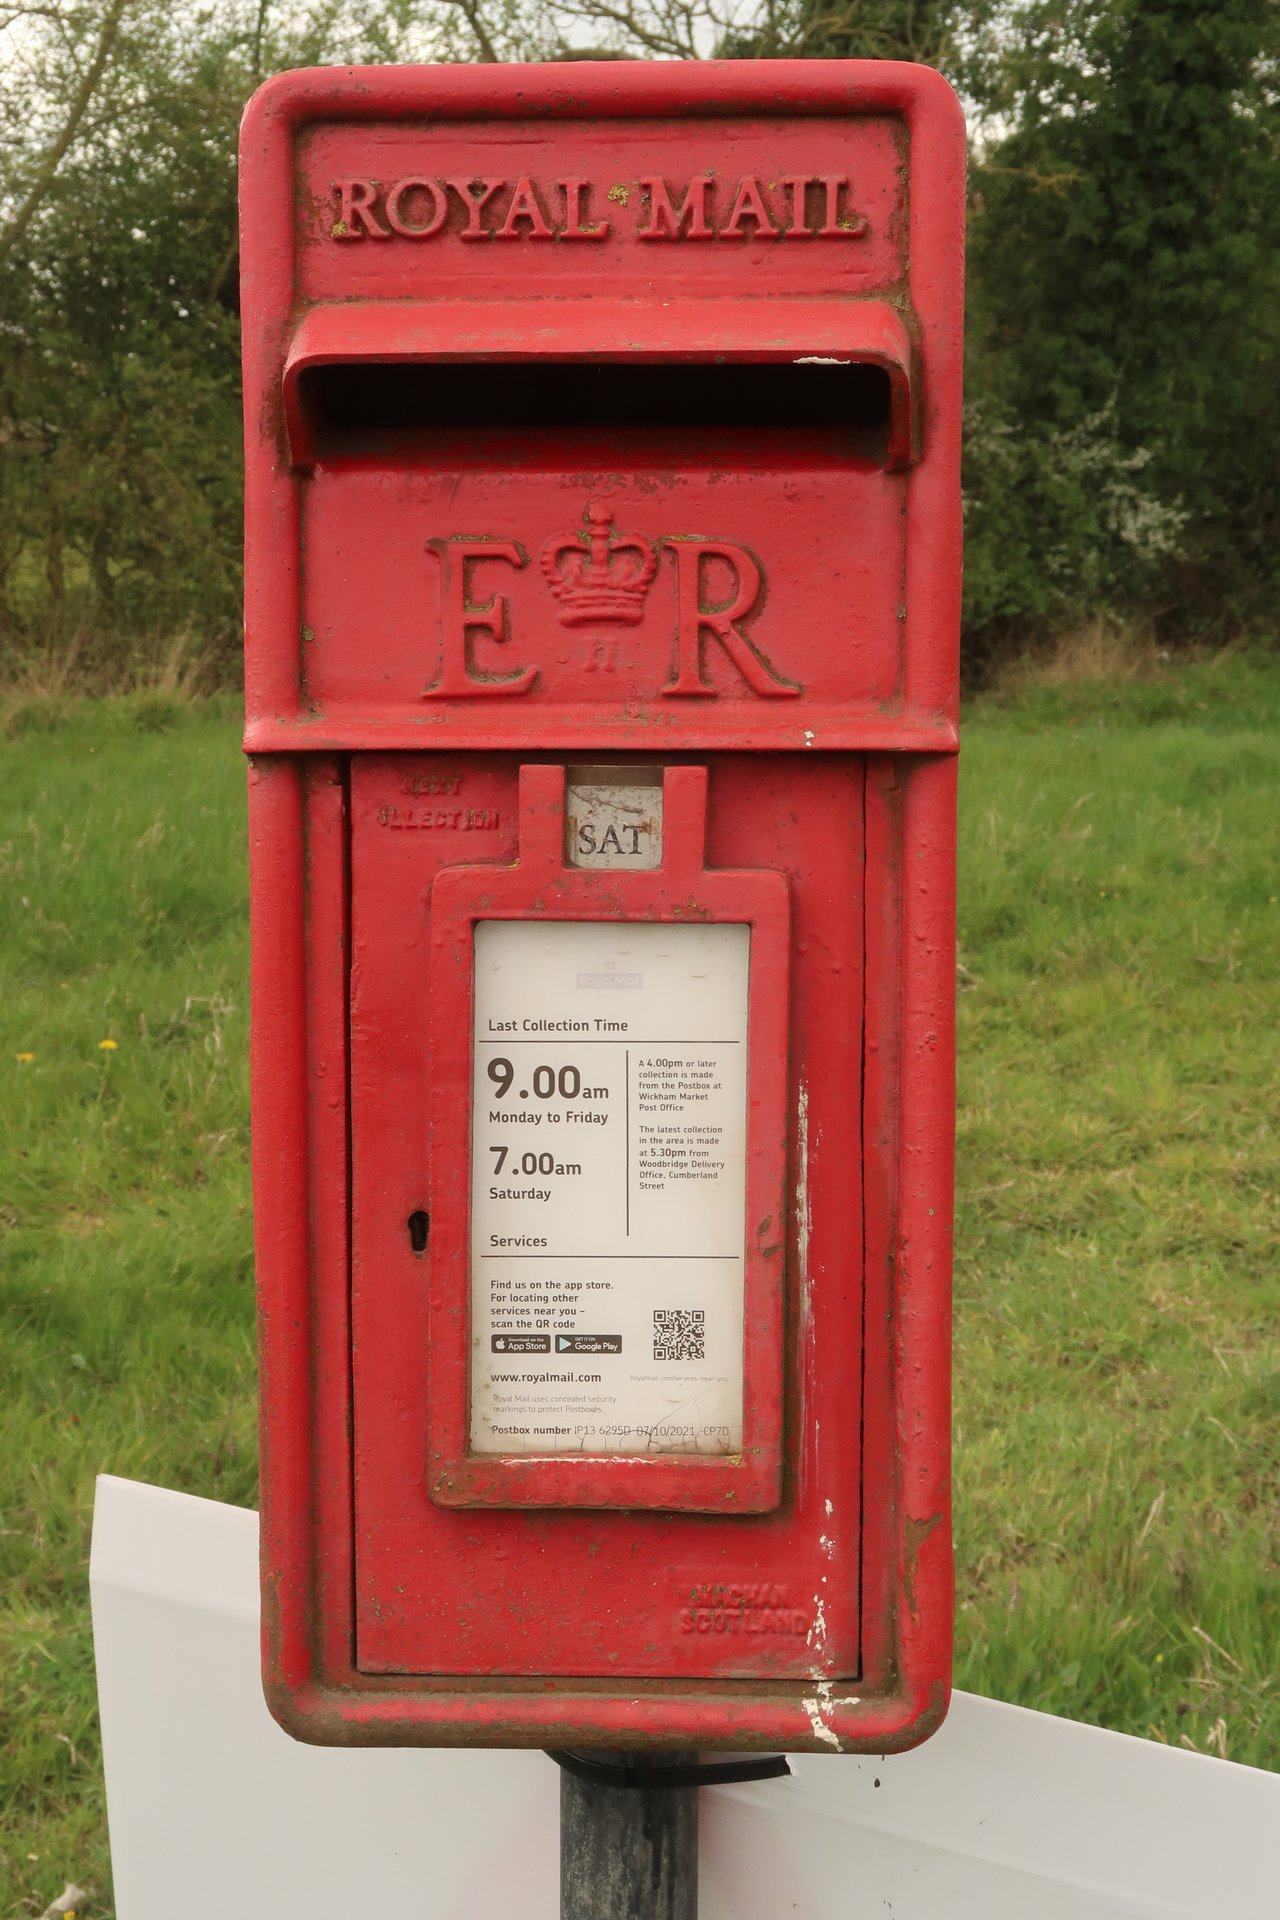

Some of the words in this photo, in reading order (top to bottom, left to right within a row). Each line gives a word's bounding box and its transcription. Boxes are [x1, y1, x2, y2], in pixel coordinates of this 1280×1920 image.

[332, 176, 610, 243] ROYAL
[637, 175, 869, 243] MAIL
[420, 533, 545, 700] E
[658, 533, 803, 699] R
[578, 824, 644, 855] SAT
[488, 1019, 518, 1032] Last
[522, 1019, 590, 1032] Collection
[593, 1019, 629, 1032] Time
[646, 1058, 683, 1070] 4.00pm
[697, 1060, 717, 1068] later
[487, 1057, 610, 1099] 9.00am
[638, 1070, 678, 1079] collection
[681, 1070, 688, 1079] is
[690, 1070, 714, 1079] made
[638, 1082, 659, 1090] from
[661, 1082, 676, 1090] the
[678, 1082, 711, 1090] Postbox
[713, 1082, 722, 1090] at
[638, 1092, 676, 1101] Wickham
[679, 1092, 709, 1101] Market
[639, 1104, 657, 1112] Post
[660, 1104, 685, 1112] Office
[489, 1111, 542, 1126] Monday
[547, 1111, 561, 1123] to
[566, 1111, 609, 1126] Friday
[640, 1126, 655, 1134] The
[657, 1126, 681, 1134] latest
[683, 1126, 723, 1134] collection
[639, 1136, 647, 1144] in
[650, 1136, 664, 1144] the
[686, 1136, 694, 1144] is
[696, 1136, 720, 1145] made
[650, 1148, 686, 1160] 5.30pm
[689, 1150, 710, 1158] from
[489, 1146, 582, 1175] 7.00am
[639, 1160, 688, 1170] Woodbridge
[691, 1160, 725, 1170] Delivery
[640, 1171, 666, 1180] Office,
[668, 1171, 718, 1180] Cumberland
[640, 1182, 665, 1190] Street
[489, 1187, 552, 1202] Saturday
[490, 1234, 548, 1247] Services
[490, 1280, 512, 1290] Find
[515, 1282, 526, 1290] us
[529, 1282, 542, 1290] on
[545, 1280, 562, 1290] the
[564, 1282, 583, 1291] app
[586, 1280, 614, 1290] store.
[490, 1293, 507, 1302] For
[510, 1293, 549, 1304] locating
[552, 1293, 580, 1302] other
[490, 1306, 531, 1316] services
[534, 1308, 557, 1316] near
[559, 1308, 577, 1317] you
[490, 1320, 513, 1328] scan
[516, 1320, 532, 1328] the
[535, 1320, 550, 1330] QR
[552, 1320, 576, 1328] code
[508, 1342, 524, 1352] App
[525, 1342, 547, 1350] Store
[574, 1342, 602, 1352] Google
[602, 1342, 619, 1351] Play
[490, 1372, 602, 1384] www.royalmail.com
[494, 1394, 512, 1403] Royal
[514, 1394, 530, 1402] Mail
[550, 1394, 586, 1402] concealed
[588, 1395, 617, 1404] security
[494, 1404, 527, 1414] markings
[538, 1406, 564, 1414] protect
[565, 1404, 602, 1413] Postboxes
[492, 1426, 530, 1434] Postbox
[533, 1426, 572, 1434] number
[679, 1607, 810, 1635] SCOTLAND
